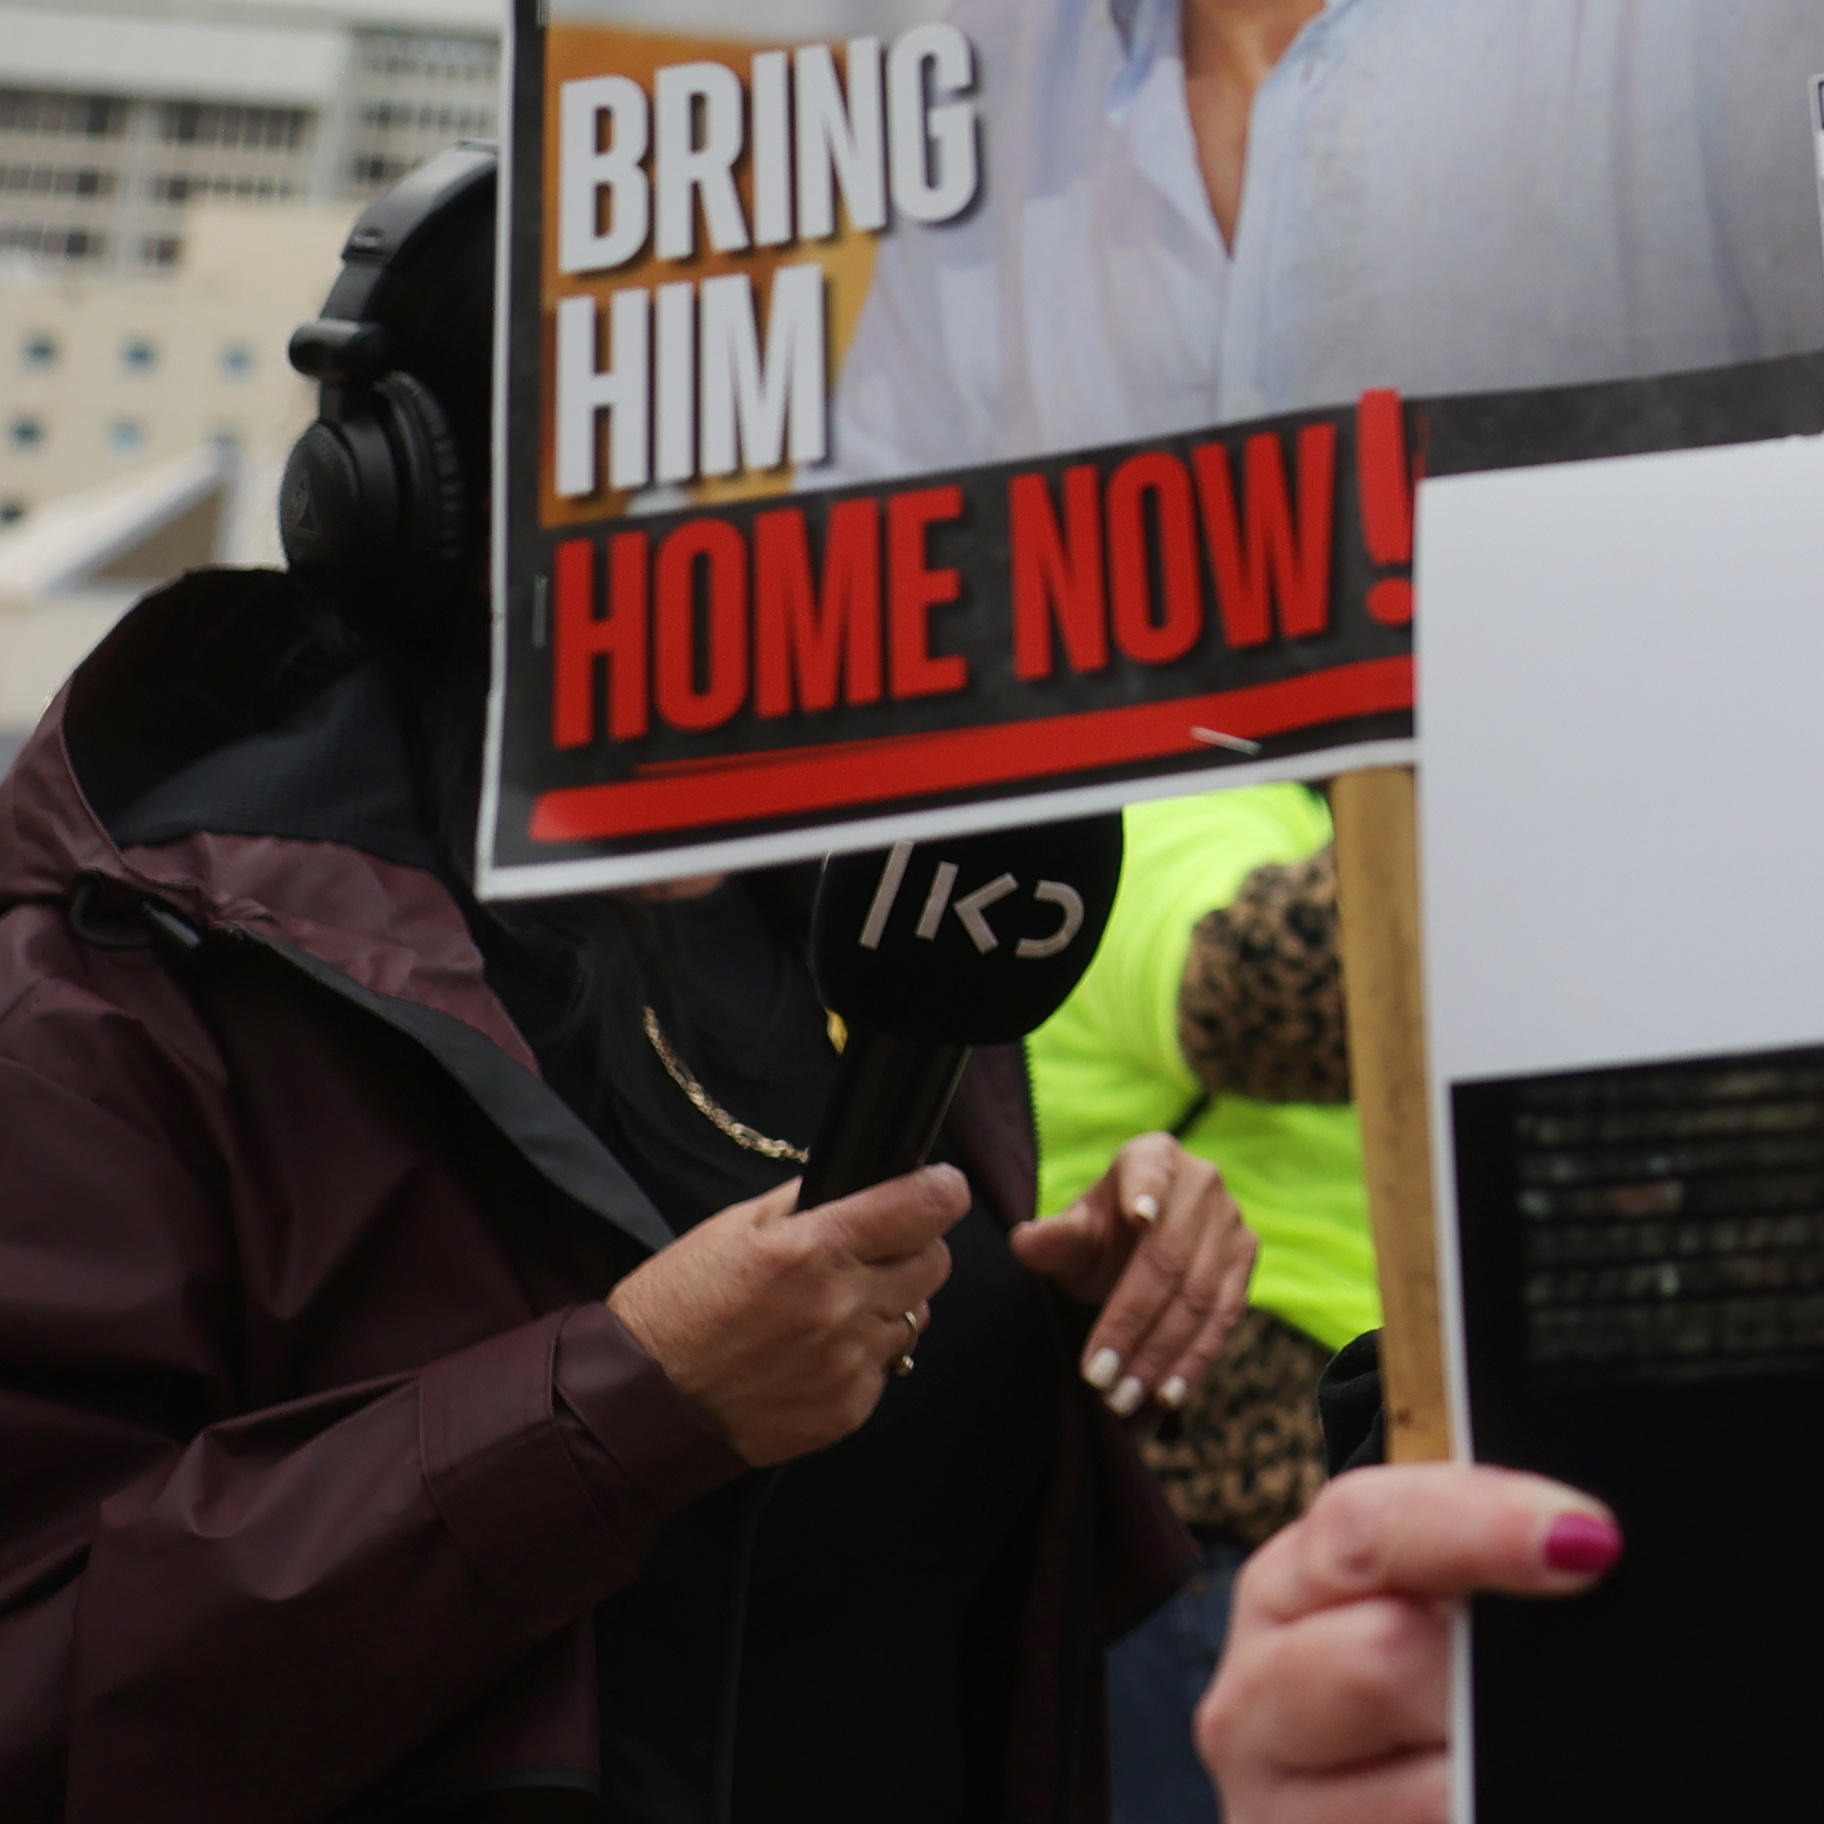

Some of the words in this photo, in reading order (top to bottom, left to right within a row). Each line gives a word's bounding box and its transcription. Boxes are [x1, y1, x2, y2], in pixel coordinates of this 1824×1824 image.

[558, 21, 978, 275] BRING
[555, 263, 828, 499] HIM
[553, 486, 969, 750] HOME
[1007, 389, 1415, 682] NOW!
